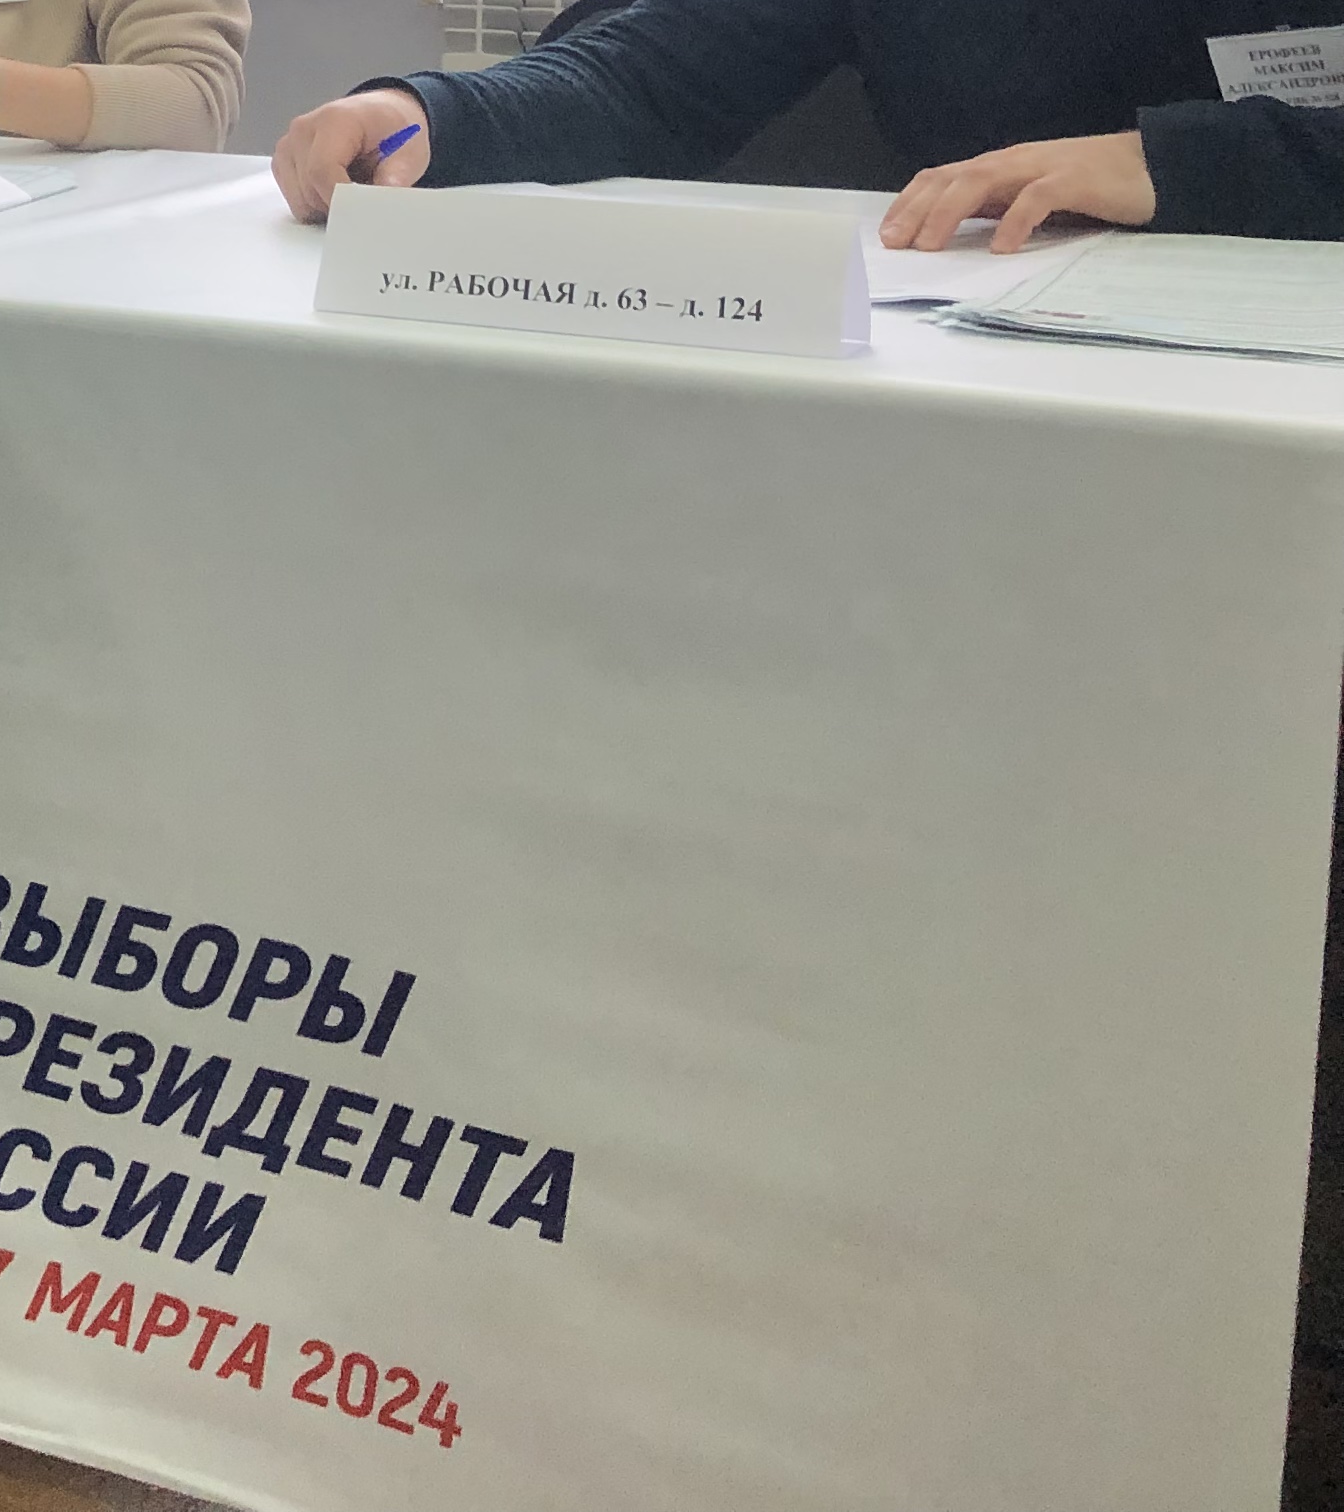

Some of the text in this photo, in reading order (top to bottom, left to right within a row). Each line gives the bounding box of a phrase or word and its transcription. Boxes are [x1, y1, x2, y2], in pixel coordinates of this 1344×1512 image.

[379, 272, 418, 294] ул.
[428, 270, 578, 305] РАБОЧАЯ
[583, 289, 608, 309] д.
[617, 287, 648, 311] 63
[679, 298, 705, 318] д.
[717, 295, 764, 323] 124
[23, 1266, 271, 1391] МАРТА
[290, 1338, 464, 1450] 2024
